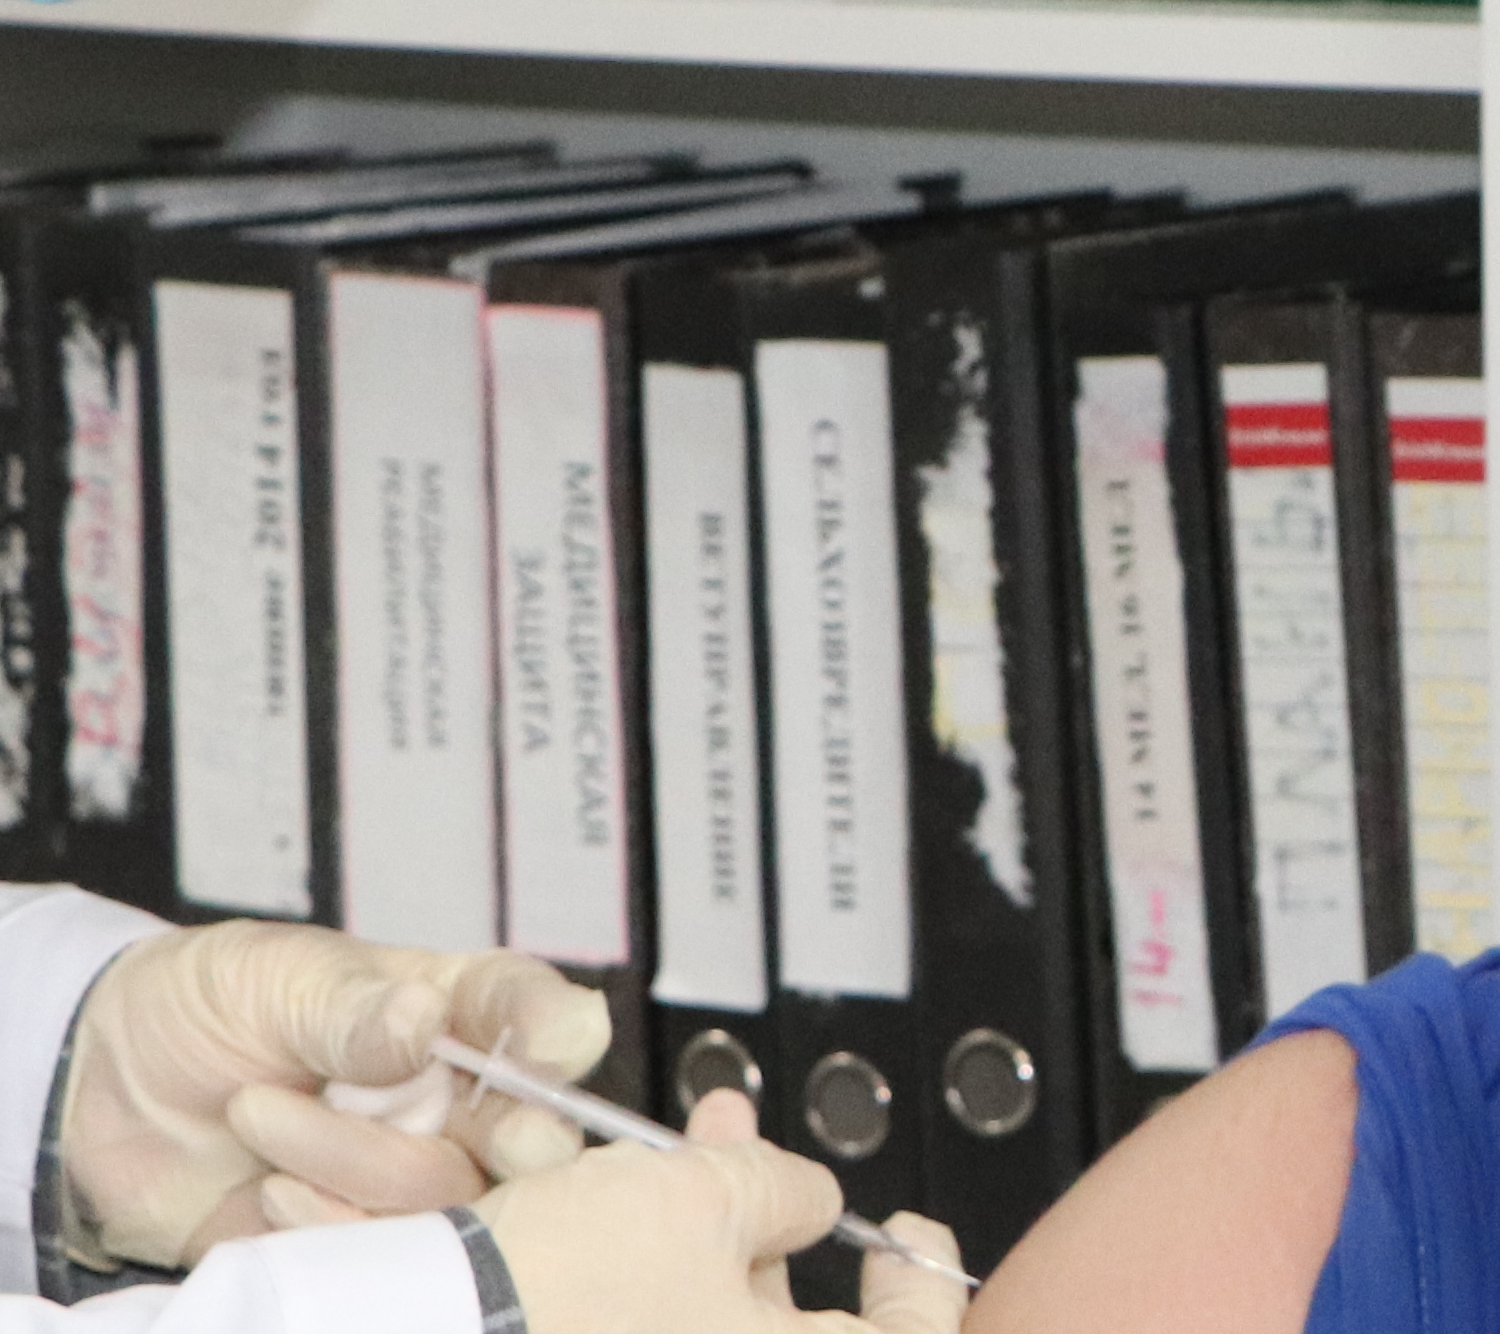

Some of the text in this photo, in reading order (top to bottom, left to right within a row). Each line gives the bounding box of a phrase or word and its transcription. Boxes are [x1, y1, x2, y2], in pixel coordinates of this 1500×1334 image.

[252, 442, 287, 552] 2014
[509, 546, 553, 757] ЗАЩИТА
[560, 459, 612, 850] МЕДИЦИНСКАЯ
